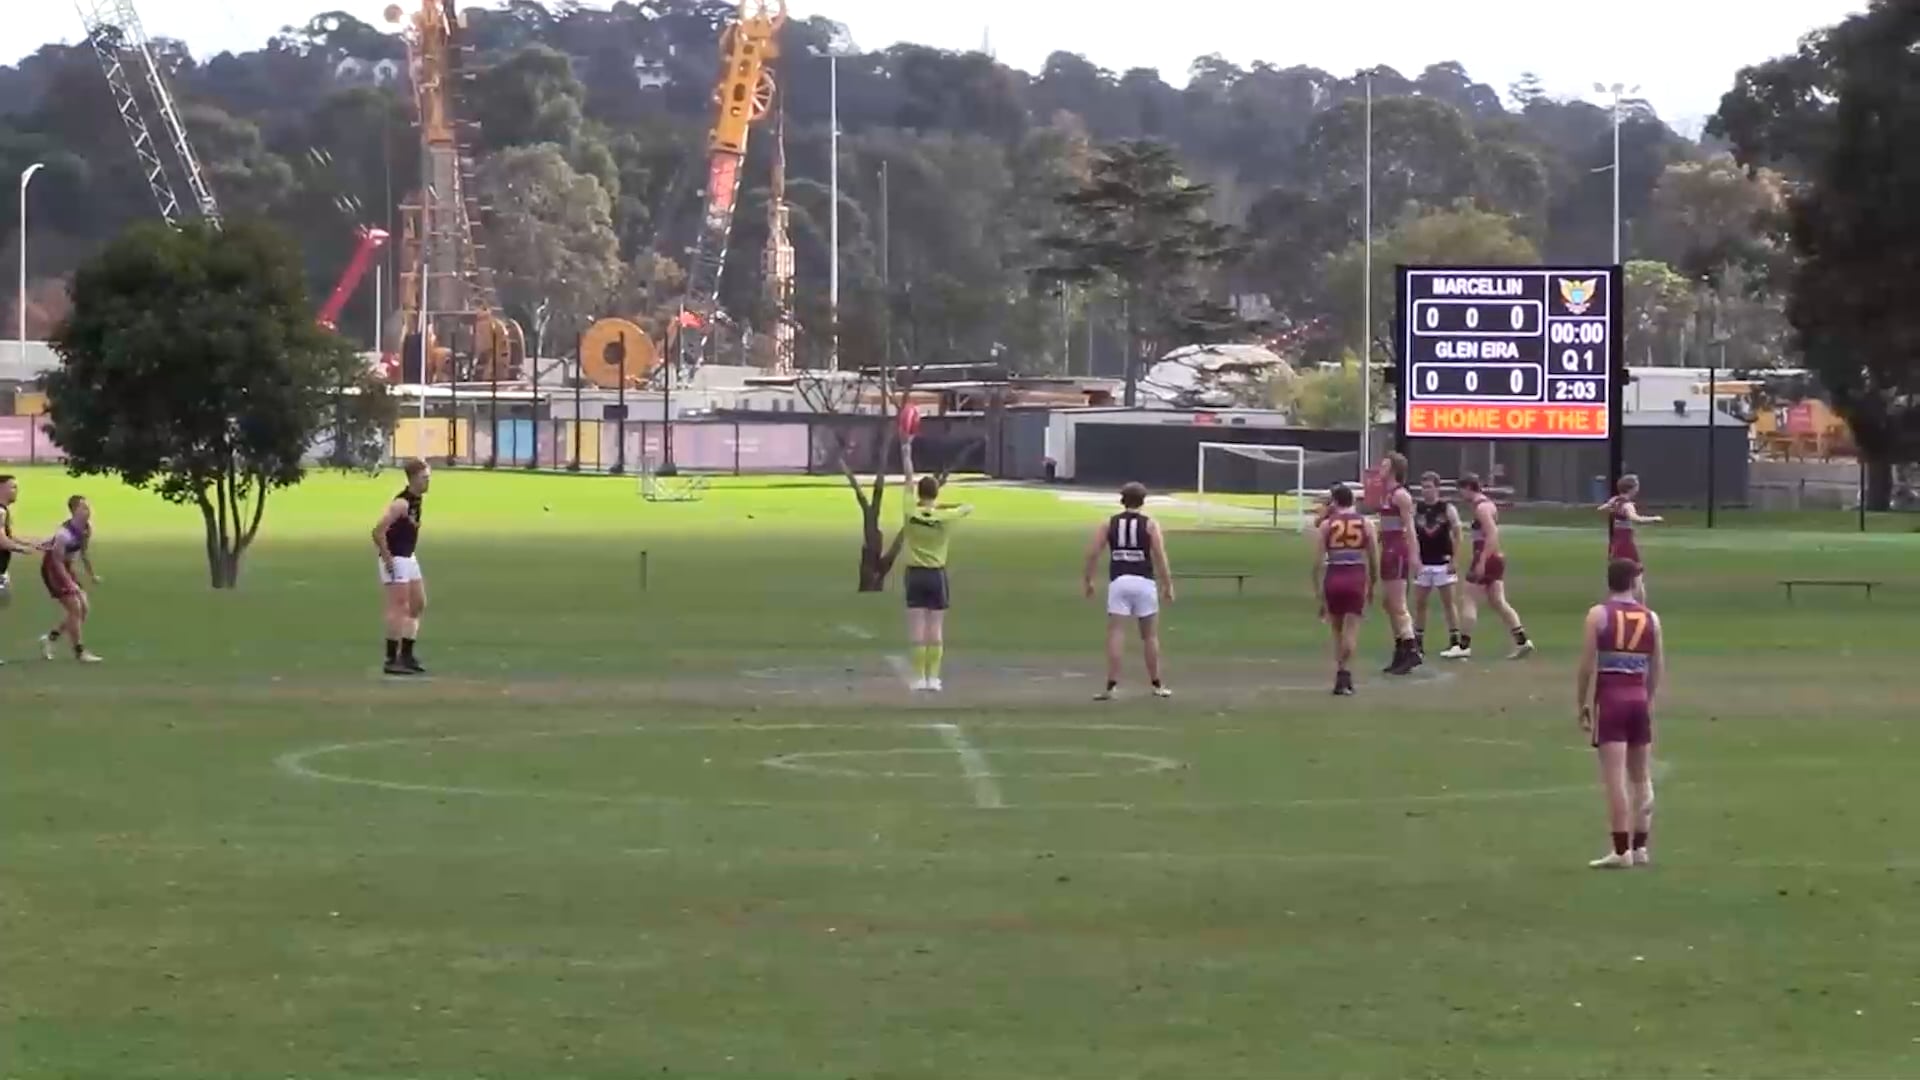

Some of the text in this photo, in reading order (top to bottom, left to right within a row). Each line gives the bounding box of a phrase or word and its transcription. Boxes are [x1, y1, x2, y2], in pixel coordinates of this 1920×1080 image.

[1432, 278, 1523, 295] MARCELLIN
[1426, 306, 1524, 330] 0 0 0
[1551, 323, 1604, 343] 00:00
[1435, 342, 1520, 359] GLEN EIRA
[1562, 349, 1594, 371] Q 1
[1426, 369, 1523, 393] 0 0 0
[1555, 381, 1596, 399] 2:03
[1412, 409, 1426, 428] E
[1433, 409, 1500, 429] HOME
[1506, 409, 1537, 429] OF
[1544, 410, 1589, 429] THE
[1117, 518, 1138, 548] 11
[1329, 519, 1363, 548] 25
[1615, 610, 1647, 650] 17
